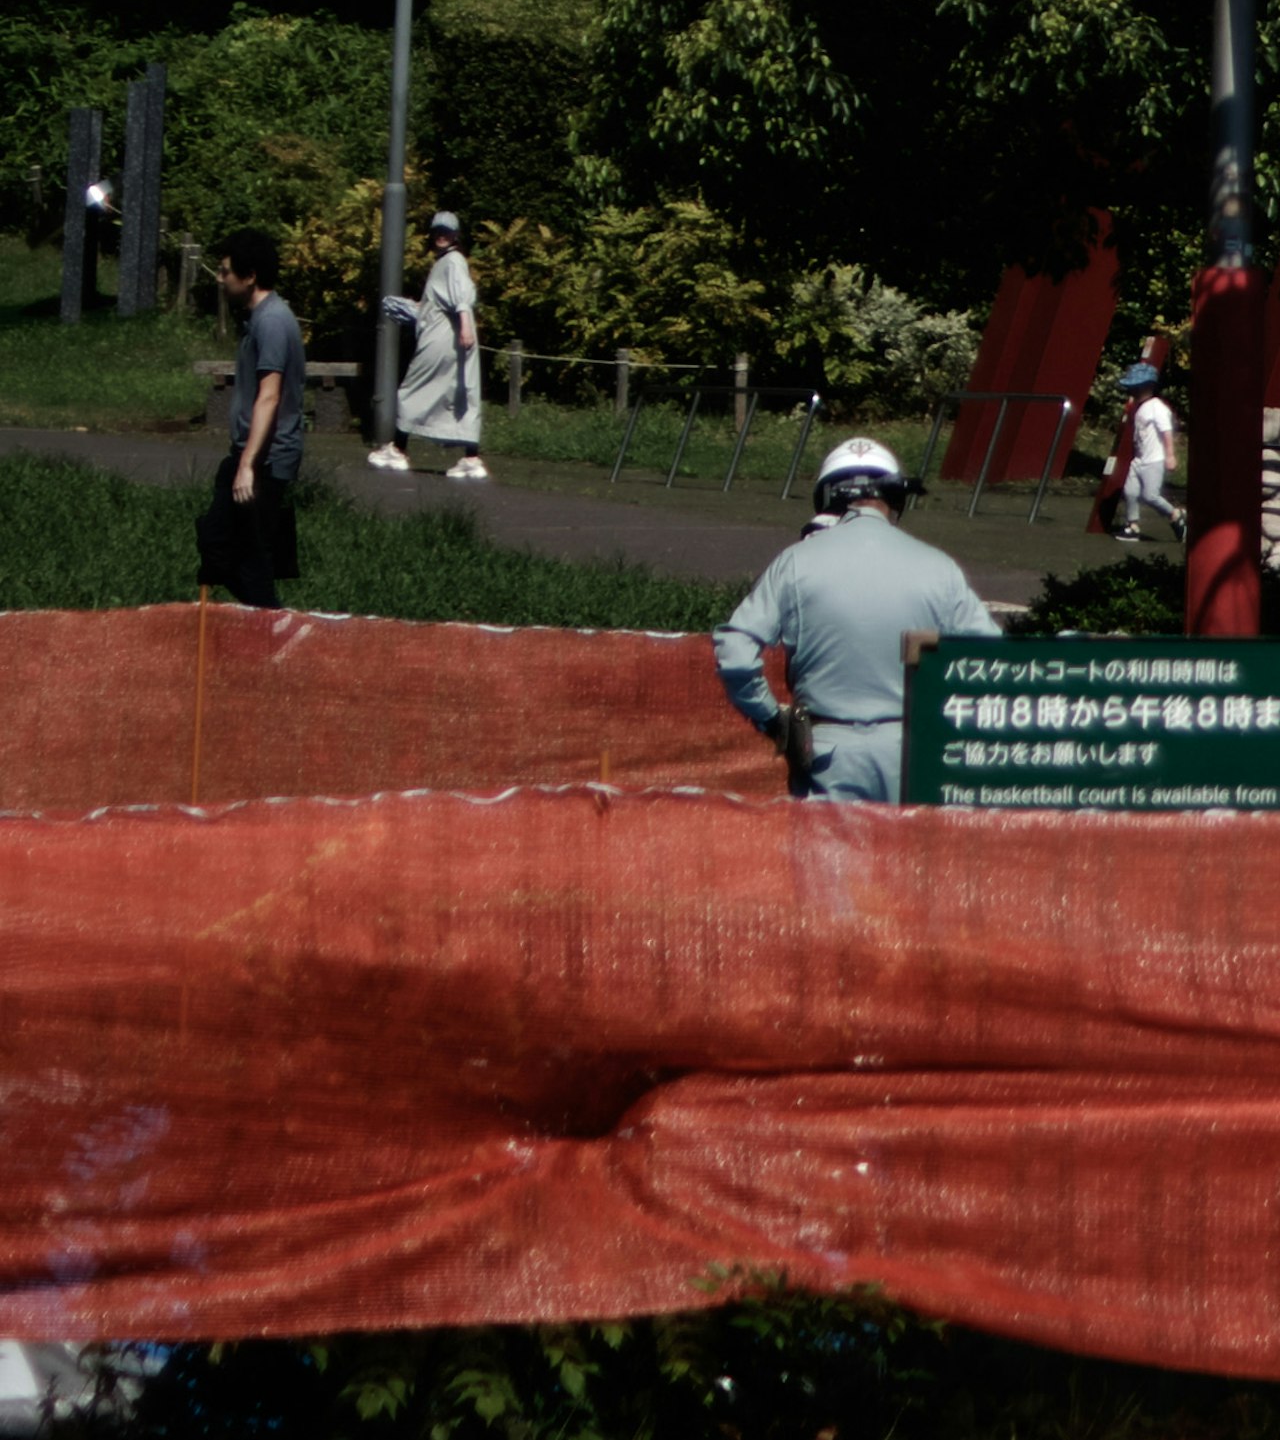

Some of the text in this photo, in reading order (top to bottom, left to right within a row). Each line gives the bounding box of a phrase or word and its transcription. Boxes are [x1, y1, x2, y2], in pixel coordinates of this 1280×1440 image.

[945, 658, 1238, 683] バスケットコートの利用時間は
[942, 740, 1159, 766] ご協力をお願いします
[941, 784, 975, 804] The
[980, 784, 1073, 805] basketball
[1078, 786, 1126, 805] court
[1131, 785, 1147, 805] is
[1151, 784, 1230, 805] available
[1236, 784, 1277, 804] from
